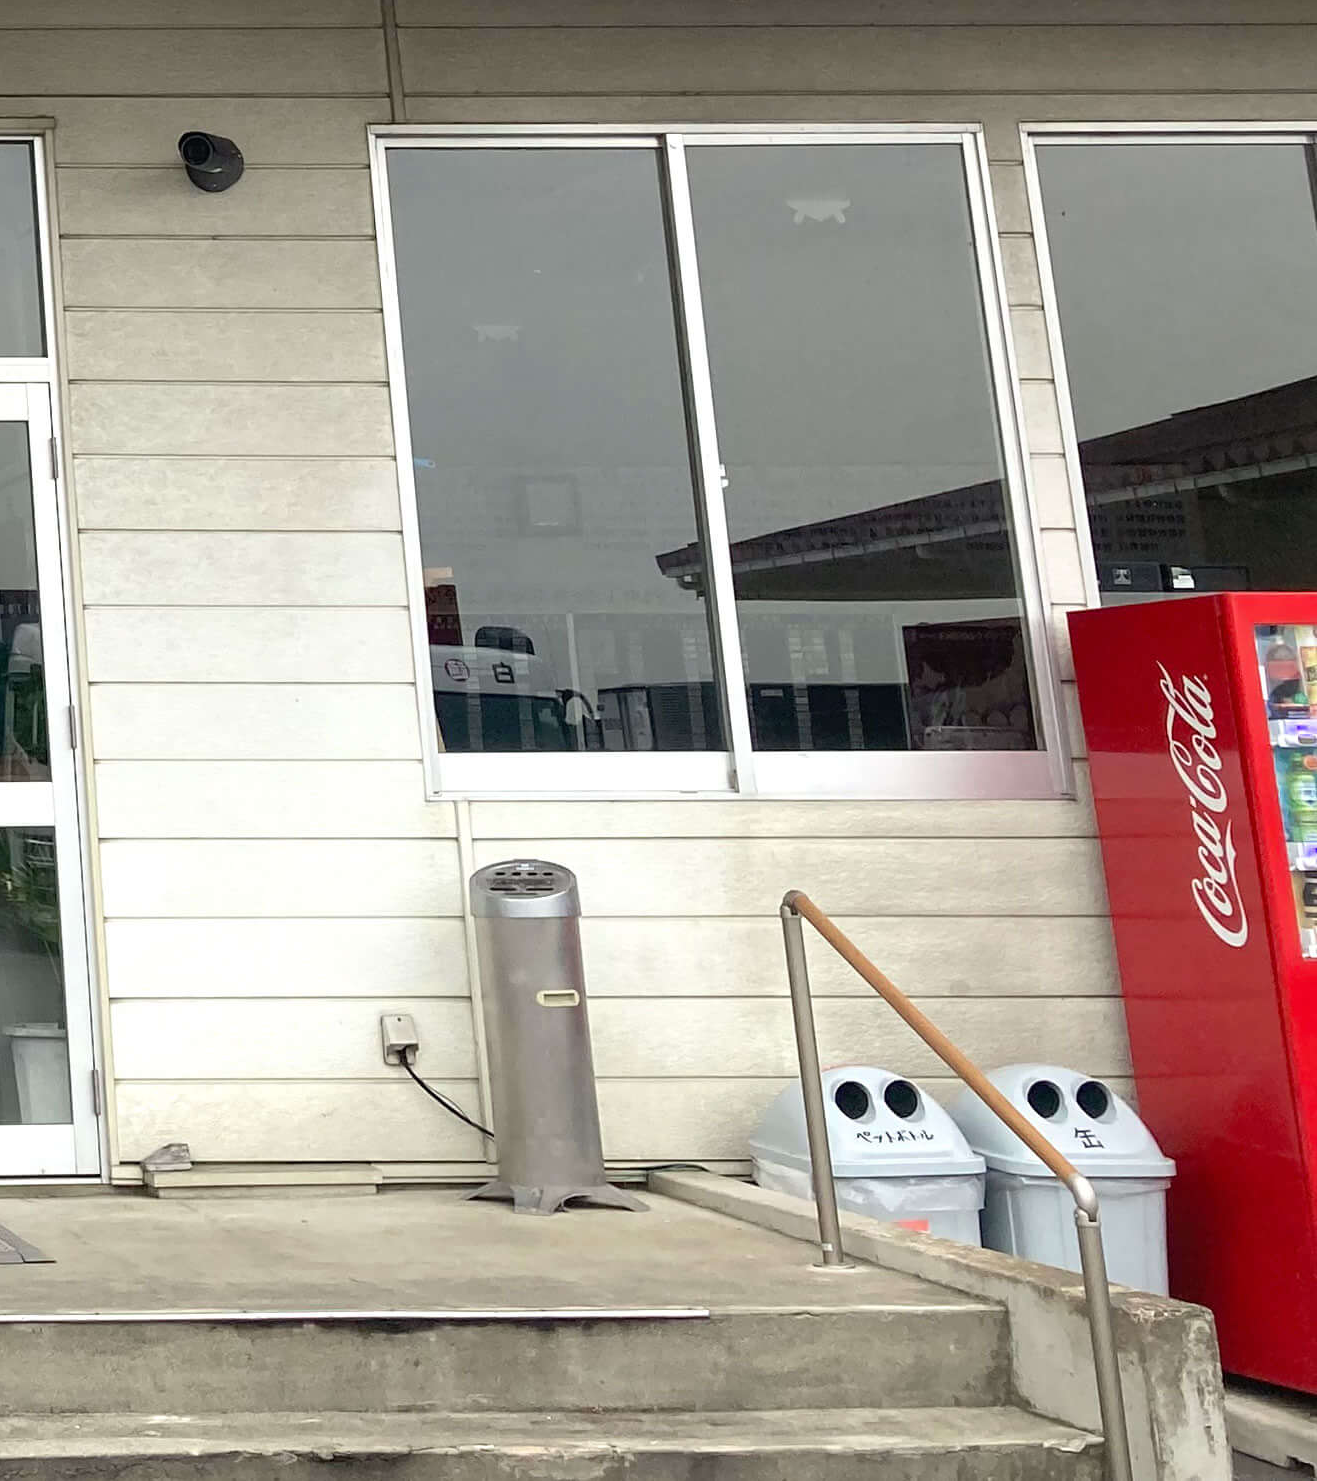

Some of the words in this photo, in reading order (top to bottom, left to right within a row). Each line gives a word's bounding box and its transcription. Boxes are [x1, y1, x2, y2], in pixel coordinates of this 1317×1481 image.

[855, 1130, 934, 1144] ペットボトル
[1074, 1127, 1104, 1150] 缶
